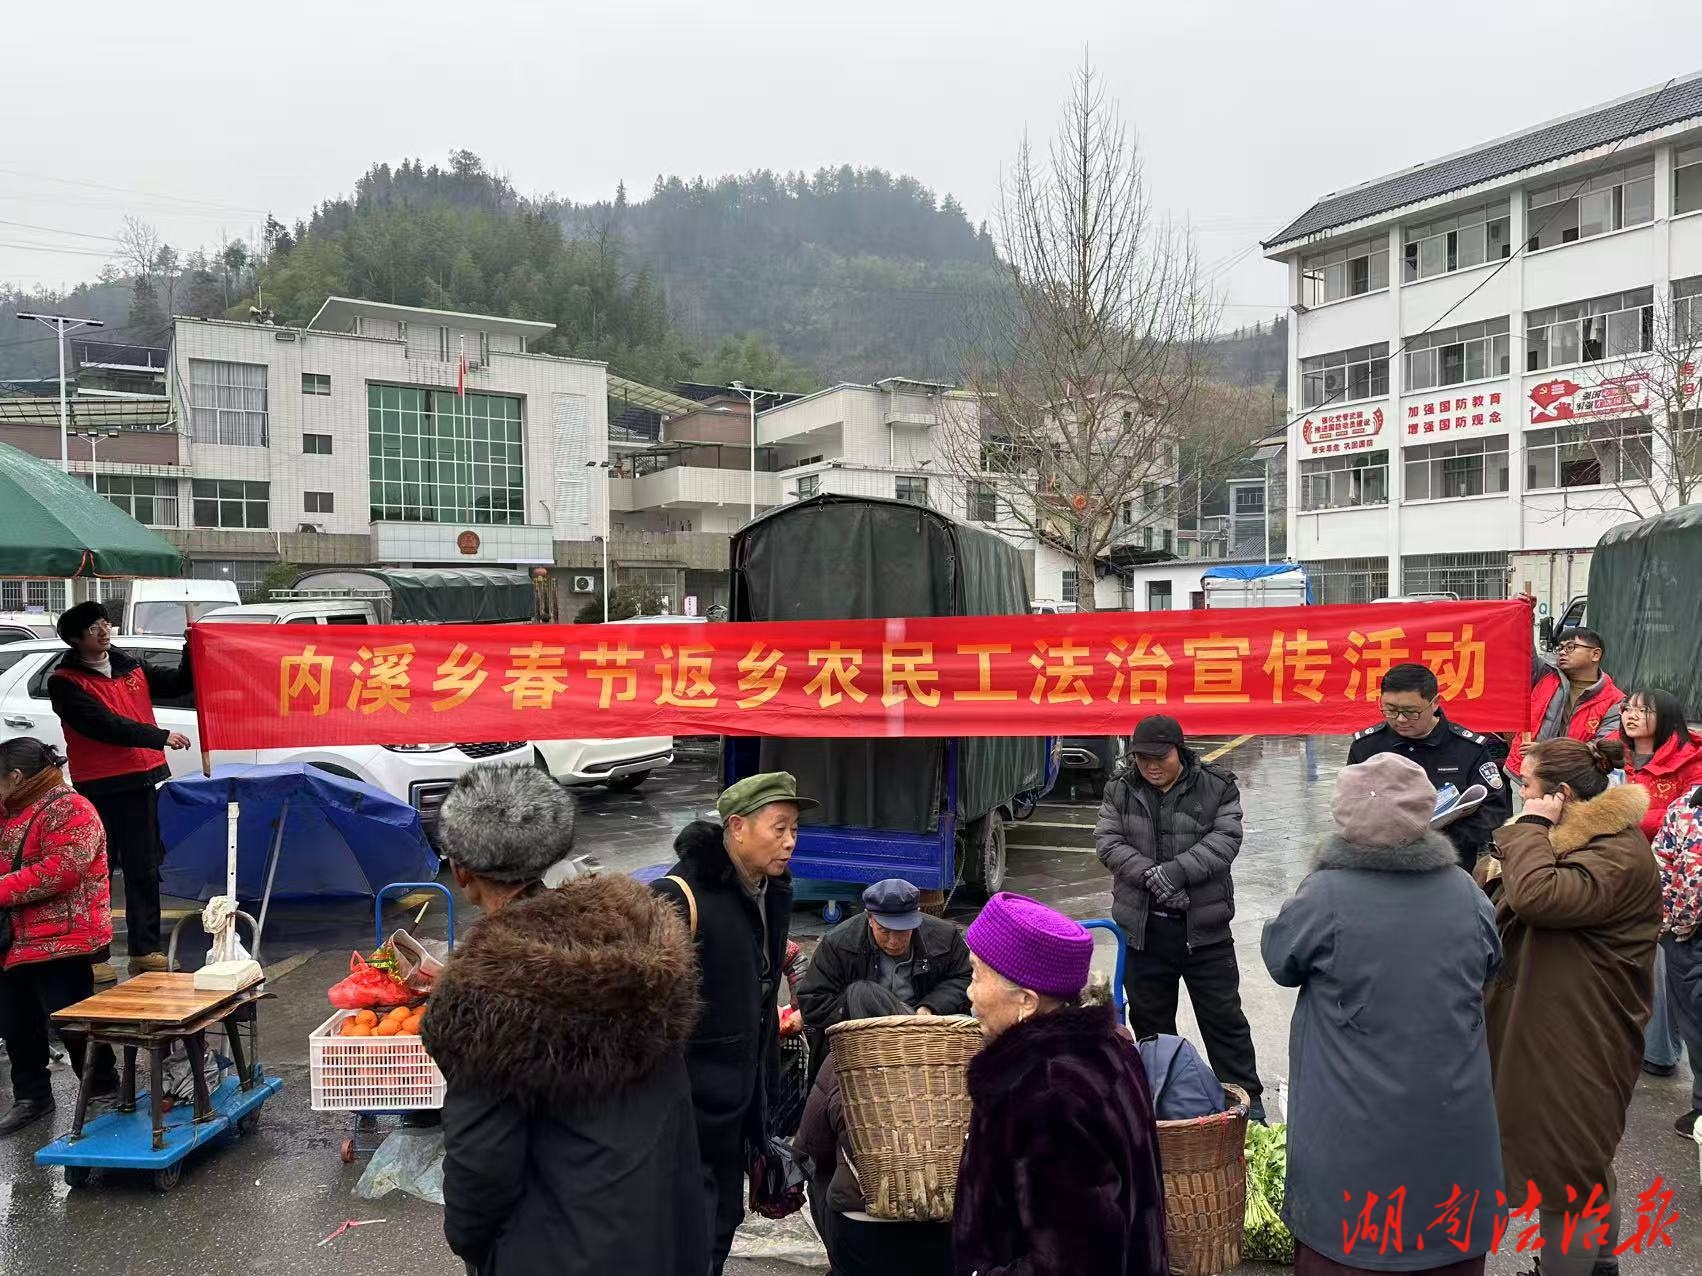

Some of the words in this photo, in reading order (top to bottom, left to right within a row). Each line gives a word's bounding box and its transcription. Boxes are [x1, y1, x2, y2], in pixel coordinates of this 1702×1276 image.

[1321, 411, 1363, 424] 强化党管武装
[1408, 393, 1501, 418] 加强国防教育
[1314, 418, 1371, 433] 推进国防动员建设
[1408, 411, 1501, 435] 增强国防观念
[279, 624, 1487, 718] 内溪乡春节返乡农民工法治宣传活动
